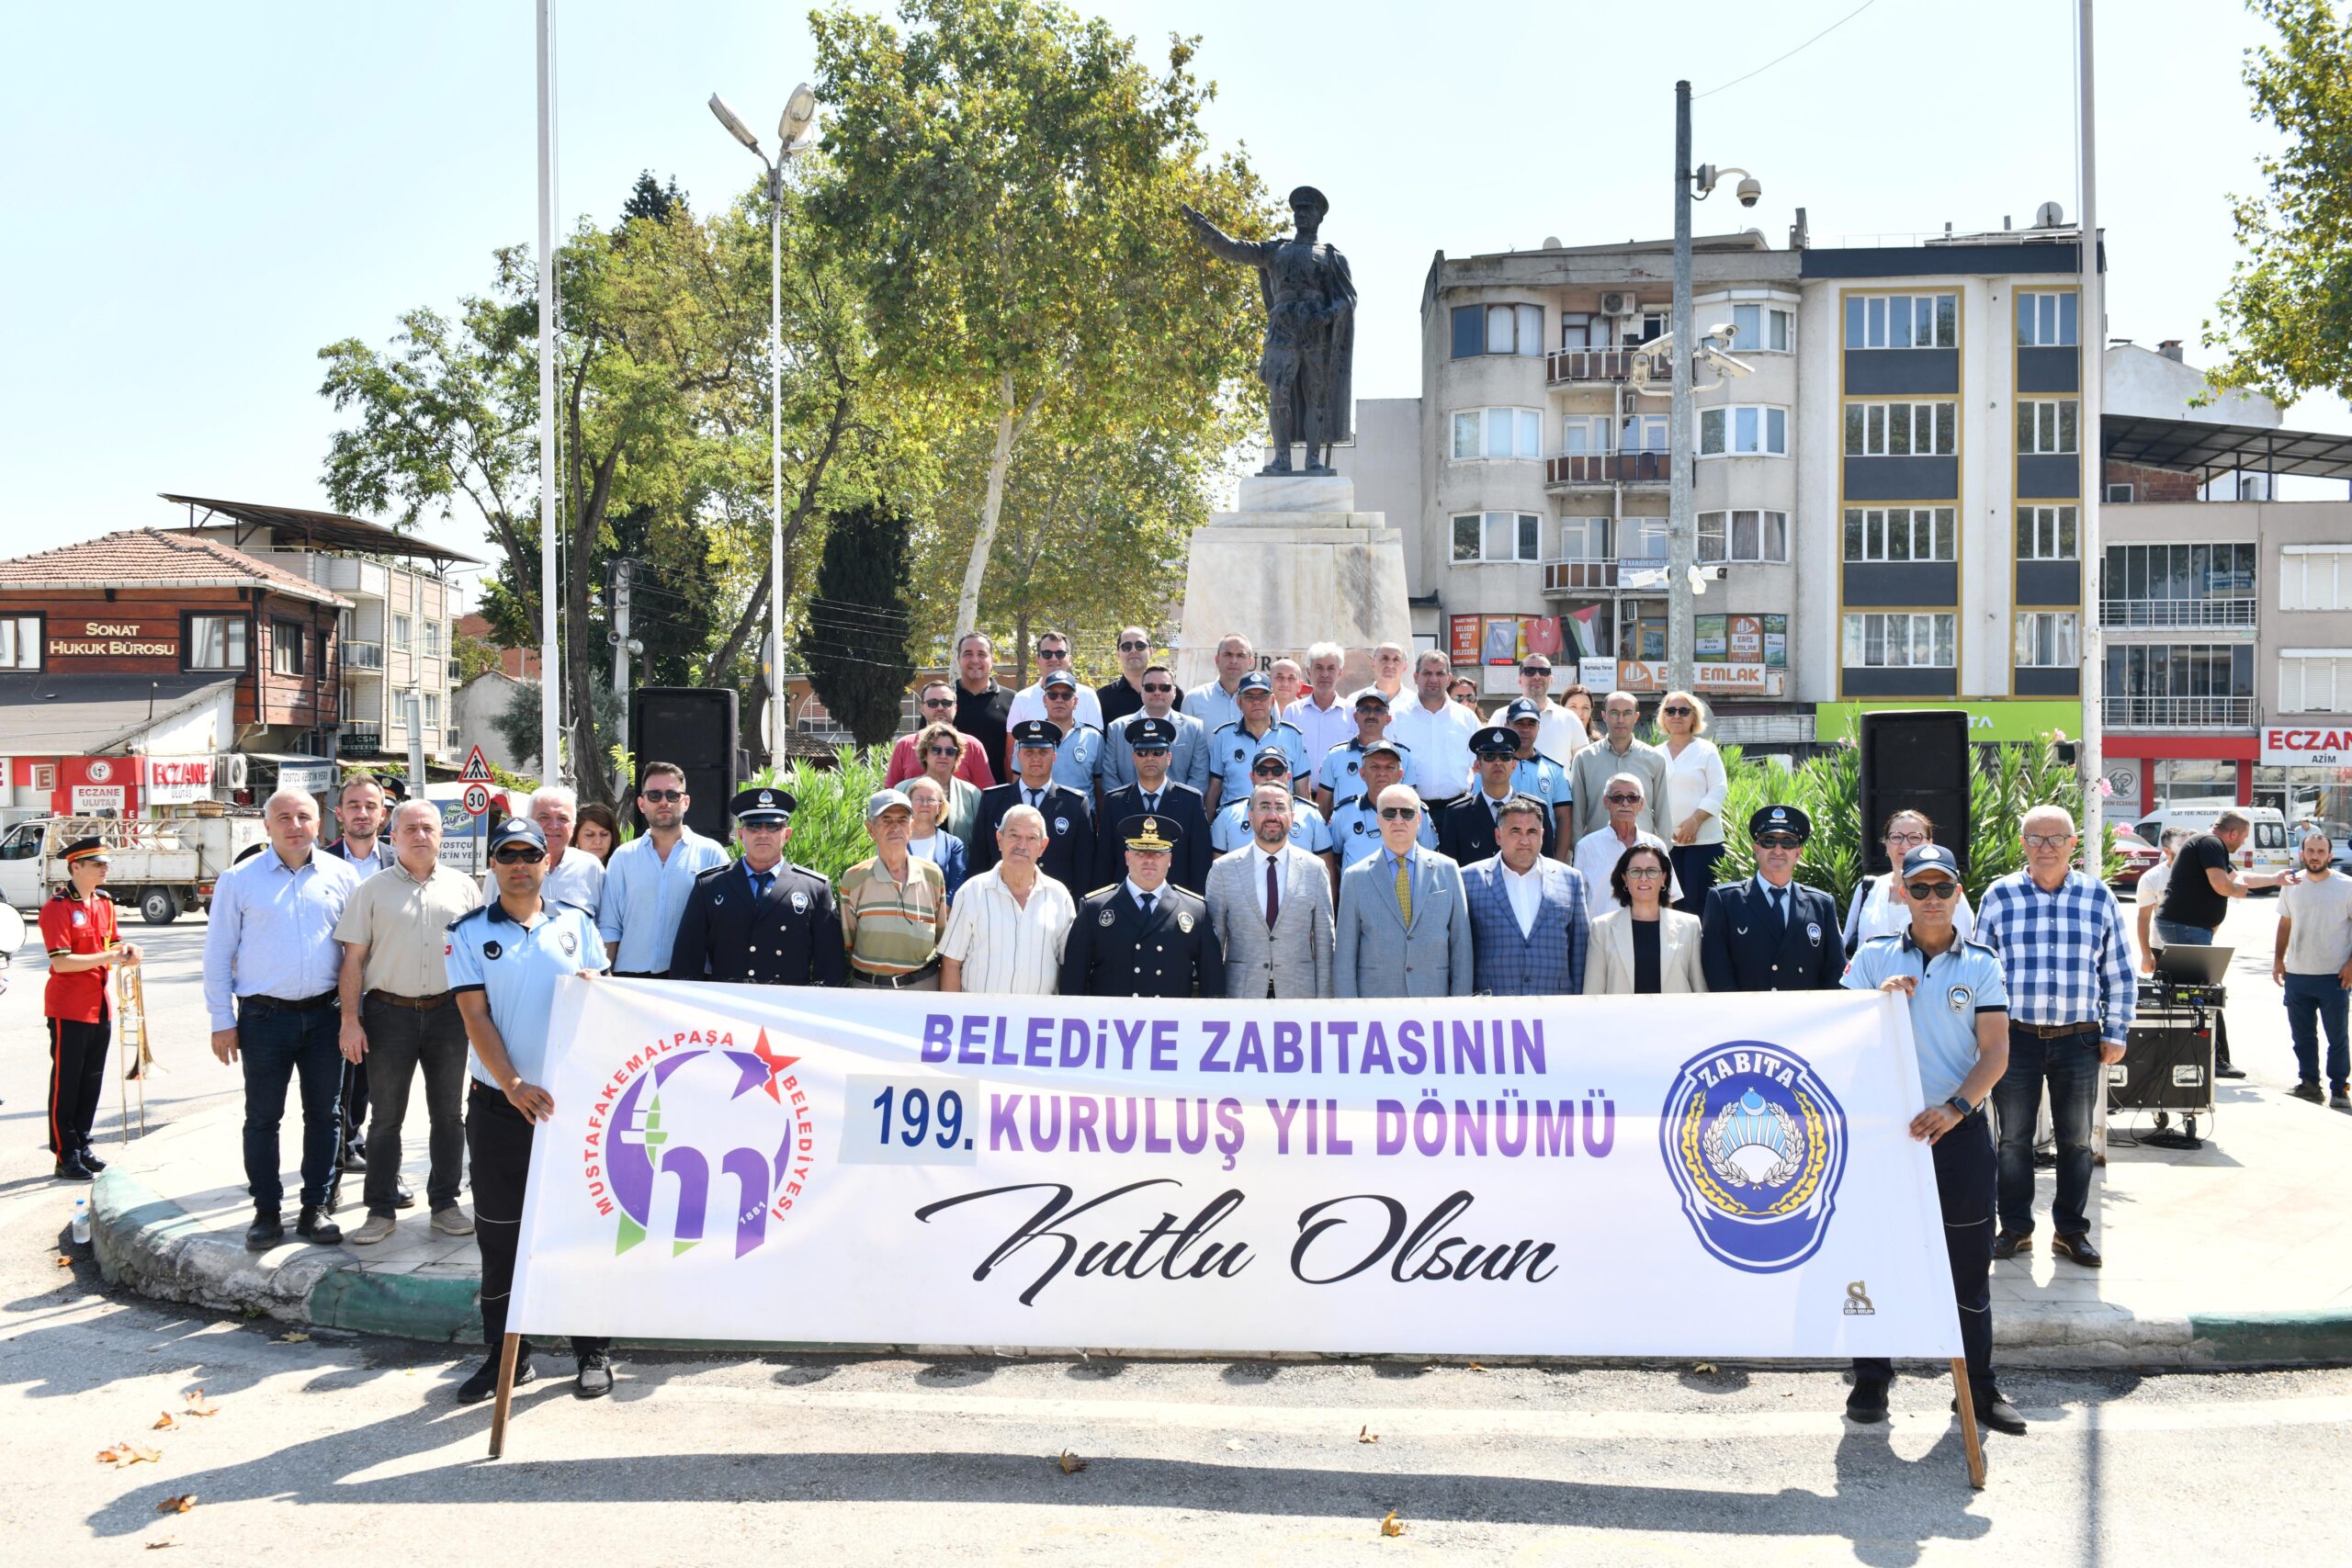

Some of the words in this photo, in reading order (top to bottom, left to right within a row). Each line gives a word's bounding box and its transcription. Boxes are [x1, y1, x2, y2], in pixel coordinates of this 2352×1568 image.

[85, 622, 140, 637] SONAT
[50, 640, 107, 655] HUKUK
[108, 641, 175, 655] BÜROSU
[1701, 667, 1760, 682] EMLAK
[356, 735, 377, 745] CSM
[2311, 753, 2336, 763] AZİM
[39, 769, 51, 787] E
[153, 762, 209, 785] ECZANE
[78, 788, 120, 797] ECZANE
[468, 793, 485, 807] 30
[439, 841, 473, 850] TOSTÇU
[1199, 1019, 1547, 1076] ZABITASININ
[1697, 1052, 1795, 1089] ZABITA
[584, 1030, 734, 1216] MUSTAFAKEMALPAŞA
[873, 1086, 974, 1151] 199.
[989, 1094, 1245, 1171] KURULUŞ
[1264, 1099, 1353, 1156] YIL
[1376, 1088, 1615, 1158] DÖNÜMÜ
[771, 1075, 814, 1222] BELEDİYESİ
[739, 1200, 767, 1225] 1881
[914, 1178, 1256, 1307] Kutlu
[1290, 1189, 1560, 1285] Olsun
